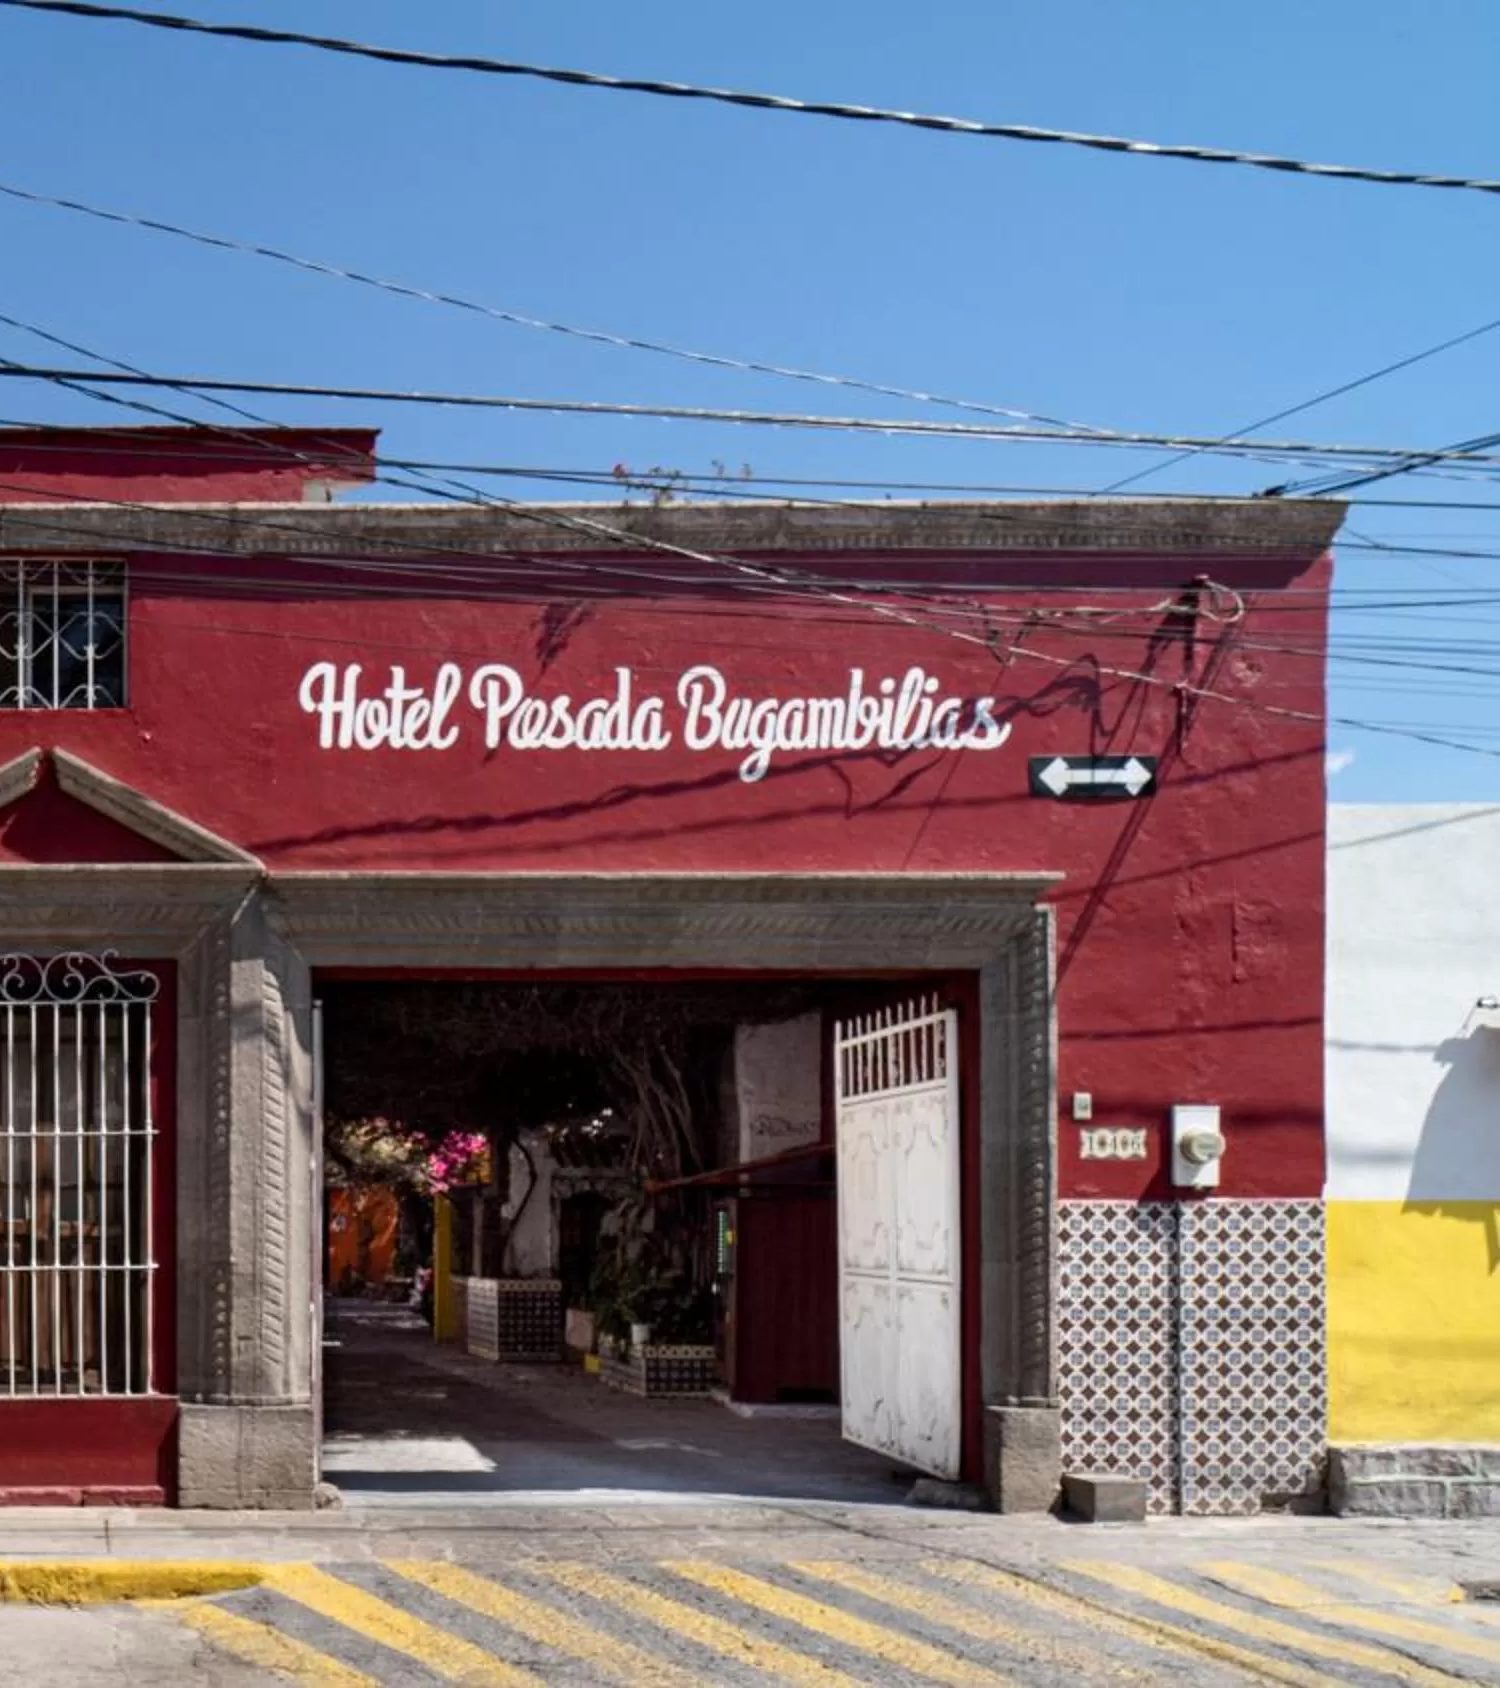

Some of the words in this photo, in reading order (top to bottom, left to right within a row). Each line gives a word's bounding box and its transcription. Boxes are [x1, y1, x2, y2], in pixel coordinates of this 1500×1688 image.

[299, 661, 462, 750] Hotel
[468, 663, 672, 751] Posada
[676, 665, 1012, 783] Bugambilias
